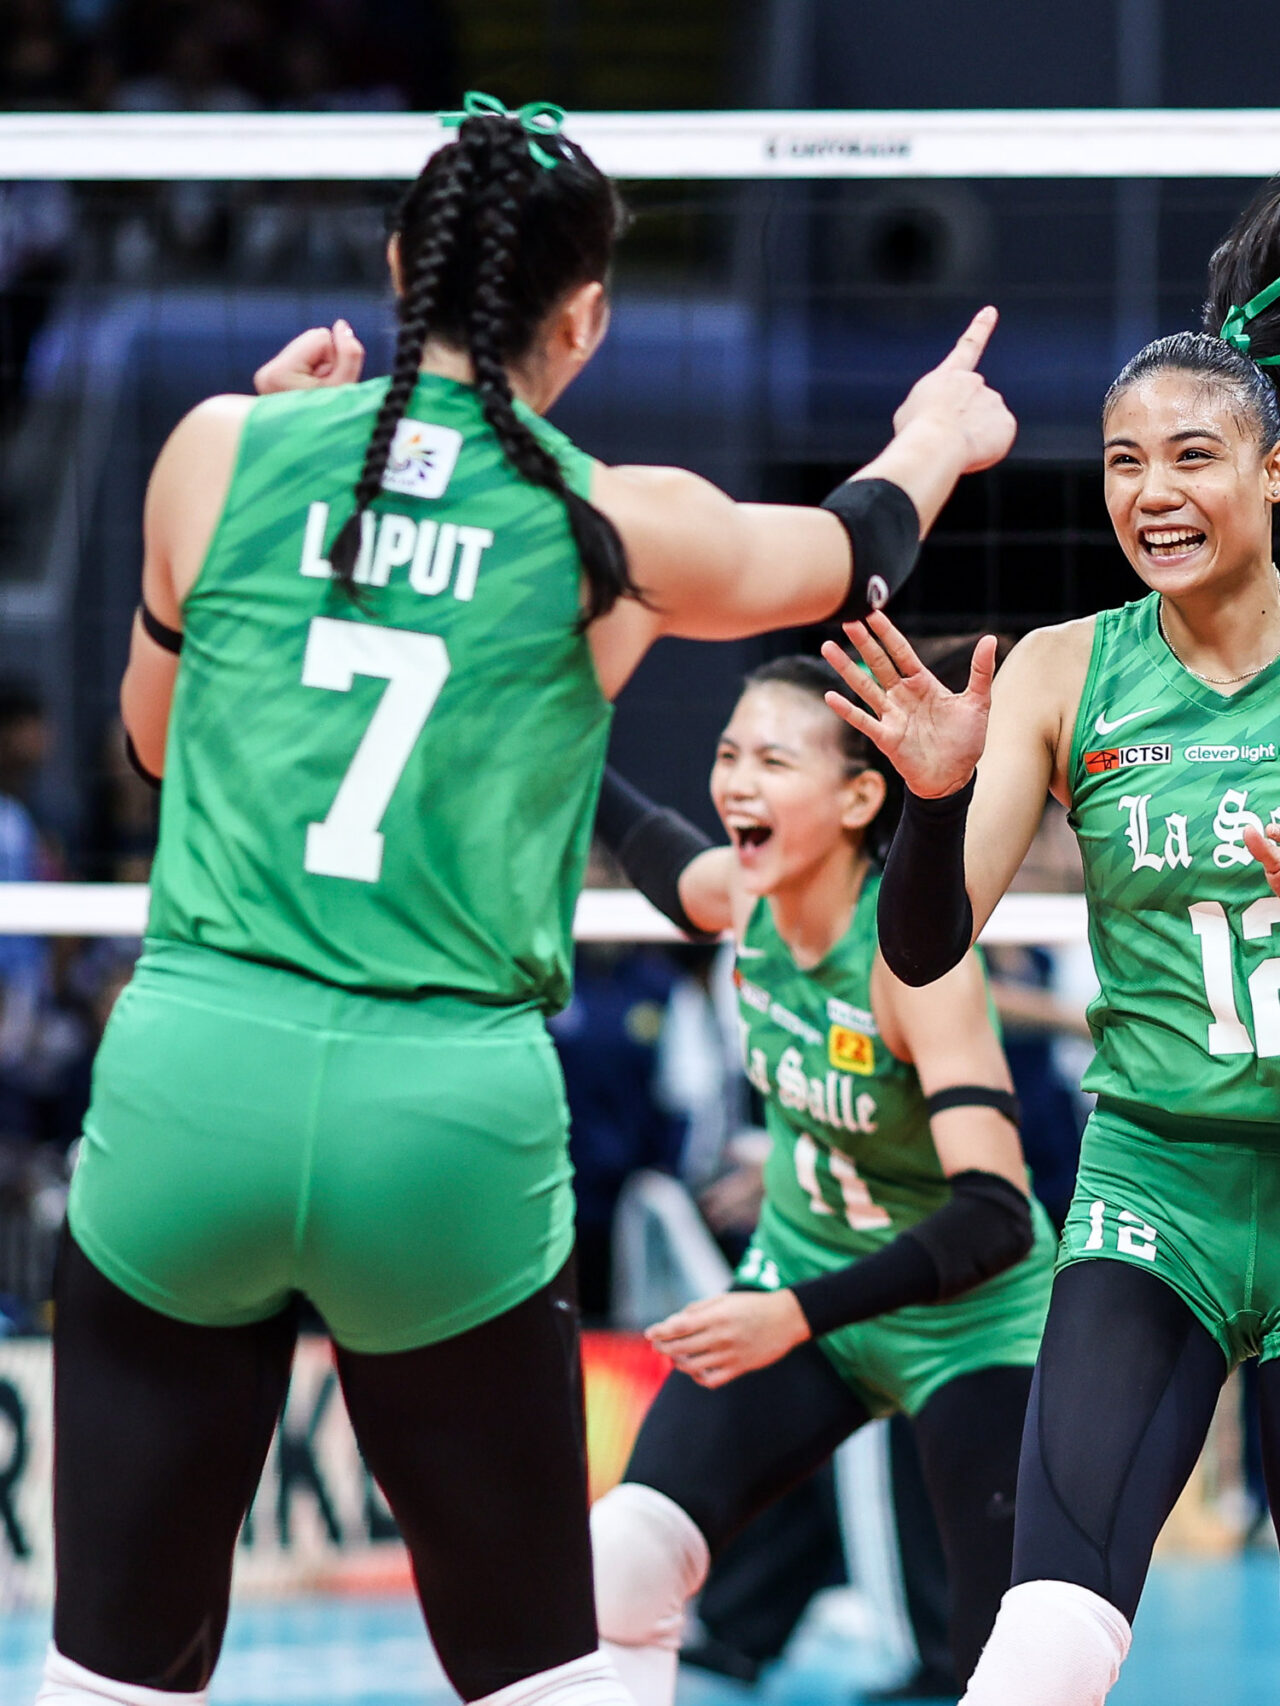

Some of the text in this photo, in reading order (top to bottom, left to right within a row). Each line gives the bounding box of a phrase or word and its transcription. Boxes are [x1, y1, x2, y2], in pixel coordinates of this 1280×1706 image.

[301, 615, 451, 883] 7
[1120, 746, 1170, 764] ICTSI
[1118, 793, 1193, 872] La
[776, 1046, 878, 1134] Salle
[794, 1132, 891, 1230] 11
[1084, 1200, 1158, 1262] 12
